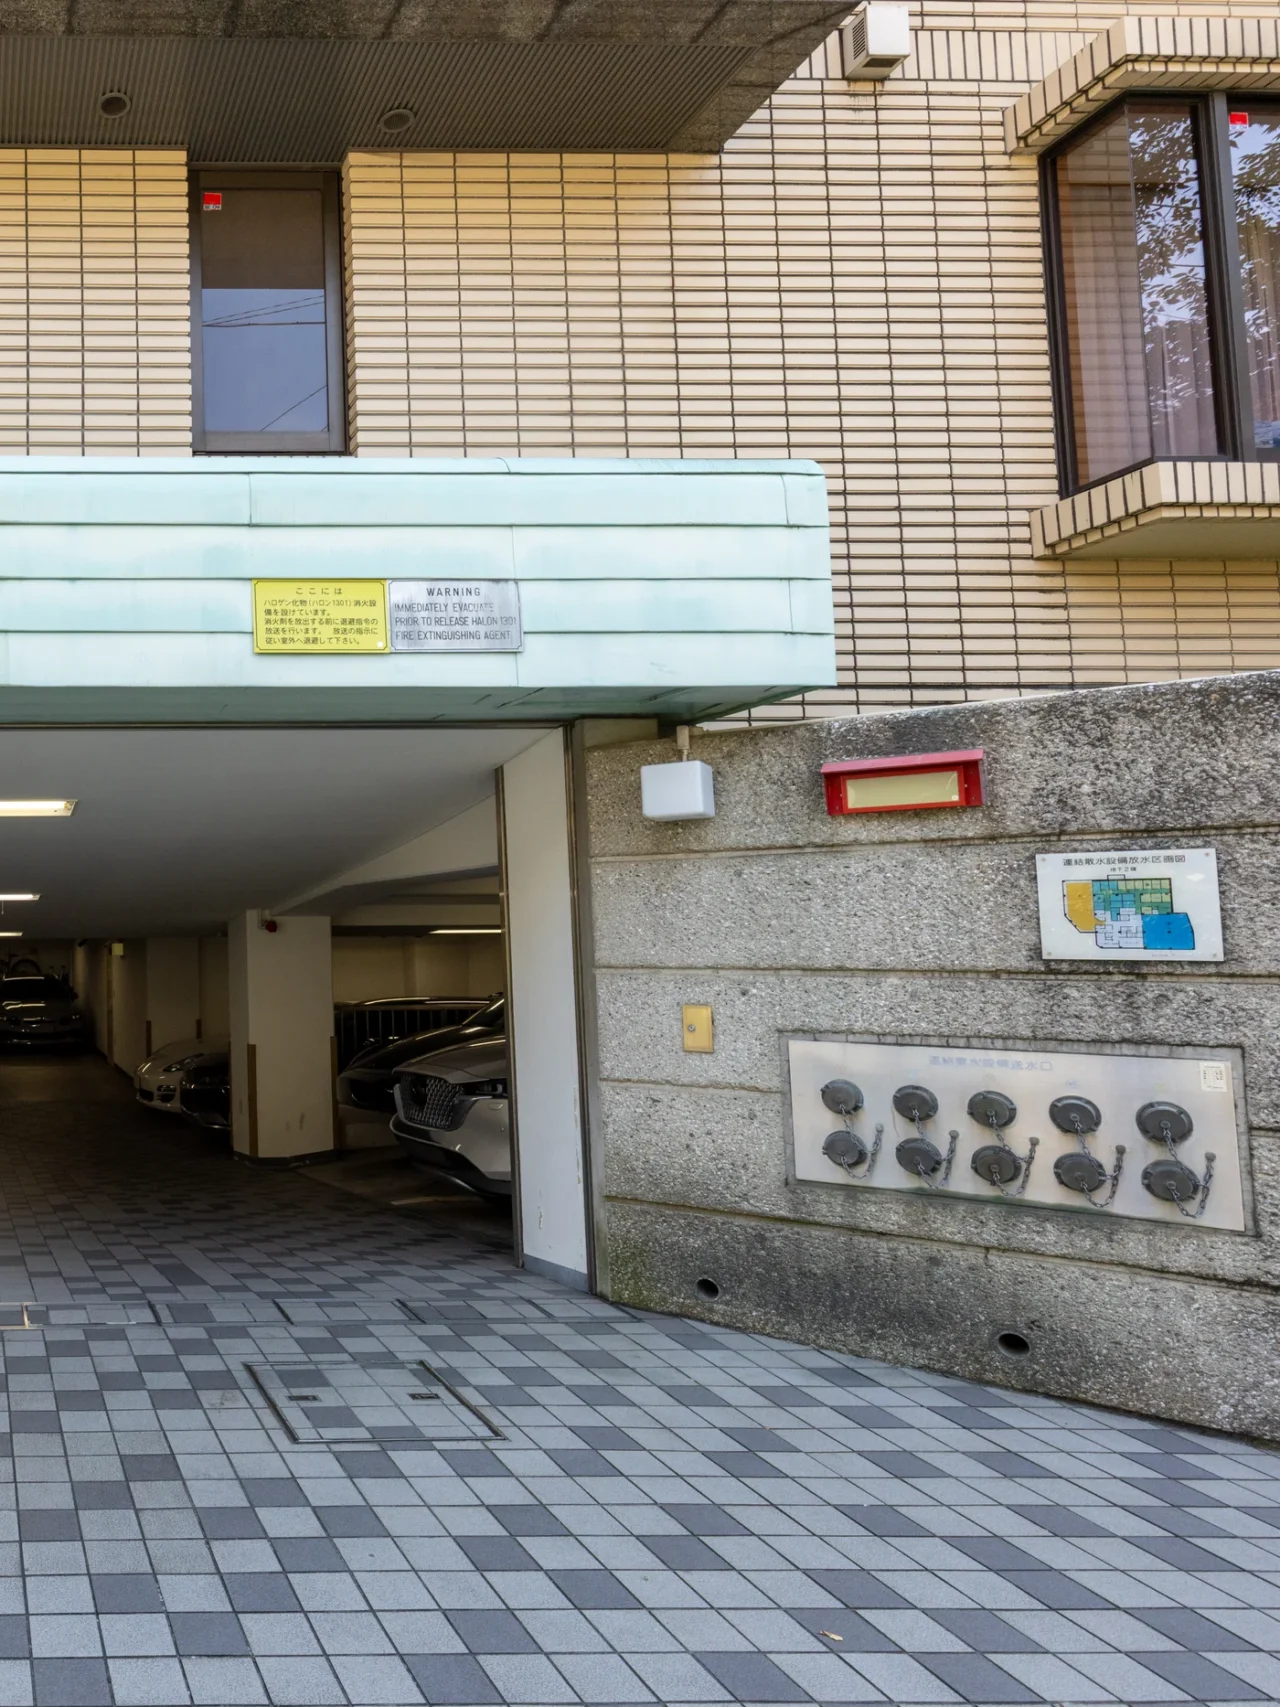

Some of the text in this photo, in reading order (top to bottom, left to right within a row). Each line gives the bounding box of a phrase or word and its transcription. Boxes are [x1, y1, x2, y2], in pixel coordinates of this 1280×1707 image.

[296, 587, 343, 595] ここには
[426, 587, 481, 596] WARNING
[264, 608, 331, 616] 備を設けています。
[394, 603, 495, 612] IMMEDIATELY EVACUATE
[395, 616, 516, 626] PRIOR TO RELEASE HALON 1301
[395, 630, 511, 640] FIRE EXTINGUISHING AGENT
[265, 636, 360, 645] 従い室外へ退避して下さい。
